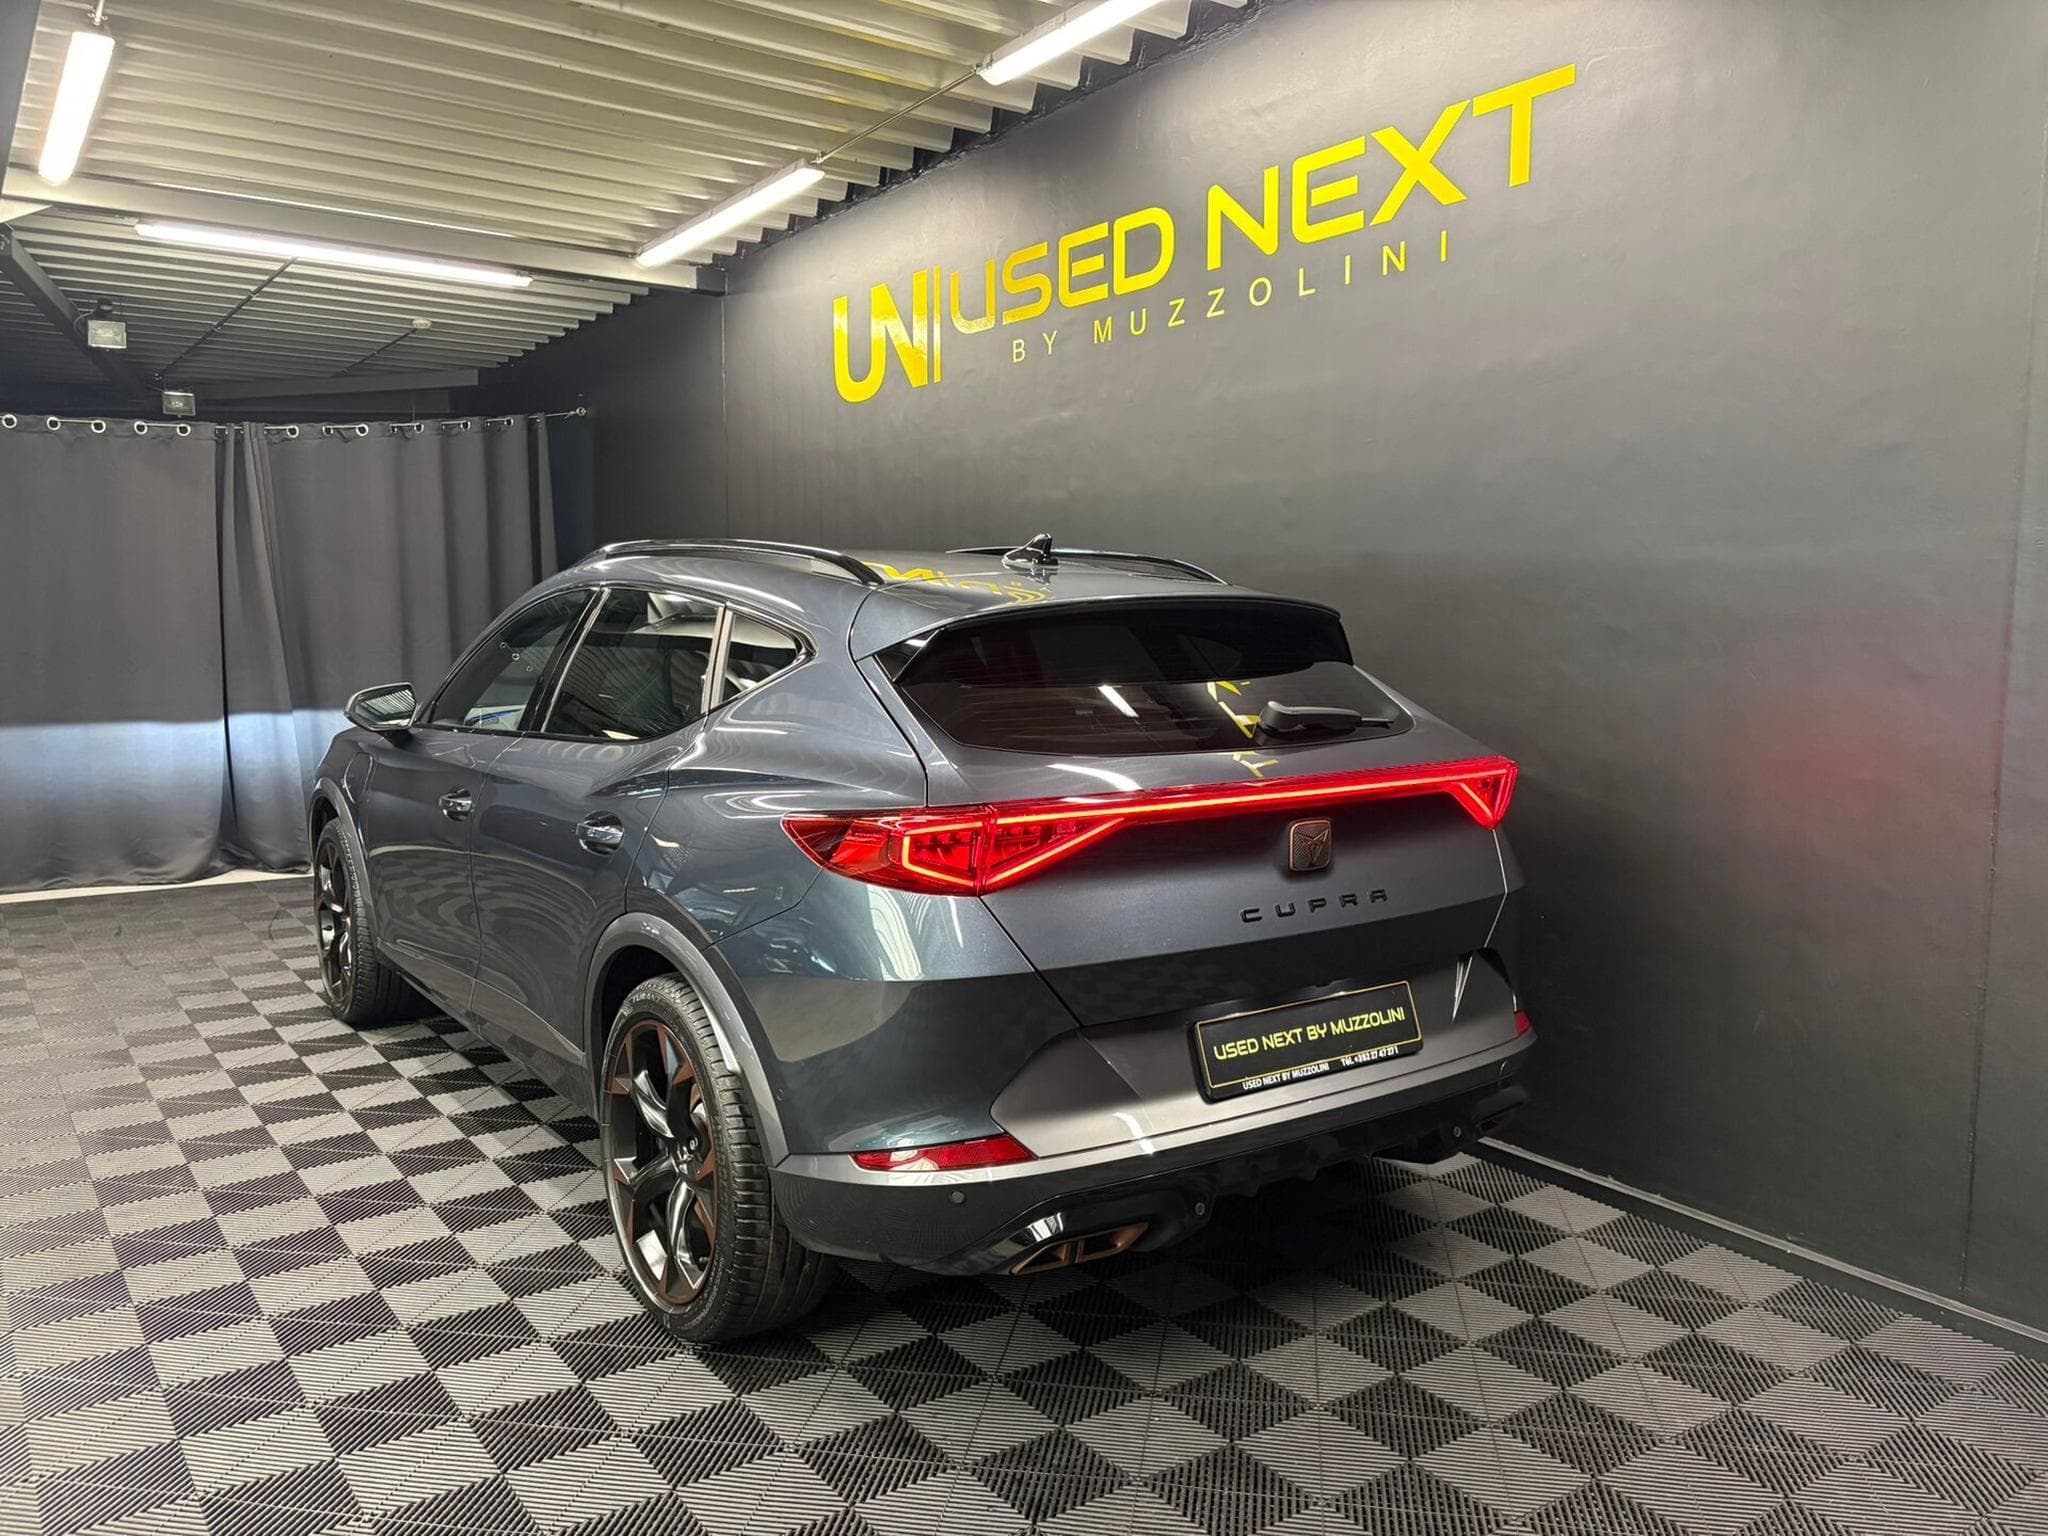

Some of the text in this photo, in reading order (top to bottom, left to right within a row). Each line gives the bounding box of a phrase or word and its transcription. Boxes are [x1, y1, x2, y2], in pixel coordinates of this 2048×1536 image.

[949, 63, 1577, 335] USED NEXT
[1011, 230, 1448, 364] BY MUZZOLINI
[1240, 888, 1389, 924] CUPRA
[1213, 1006, 1406, 1060] USED NEXT BY MUZZOLINI
[1242, 1078, 1263, 1090] USED
[1263, 1073, 1281, 1086] NEXT
